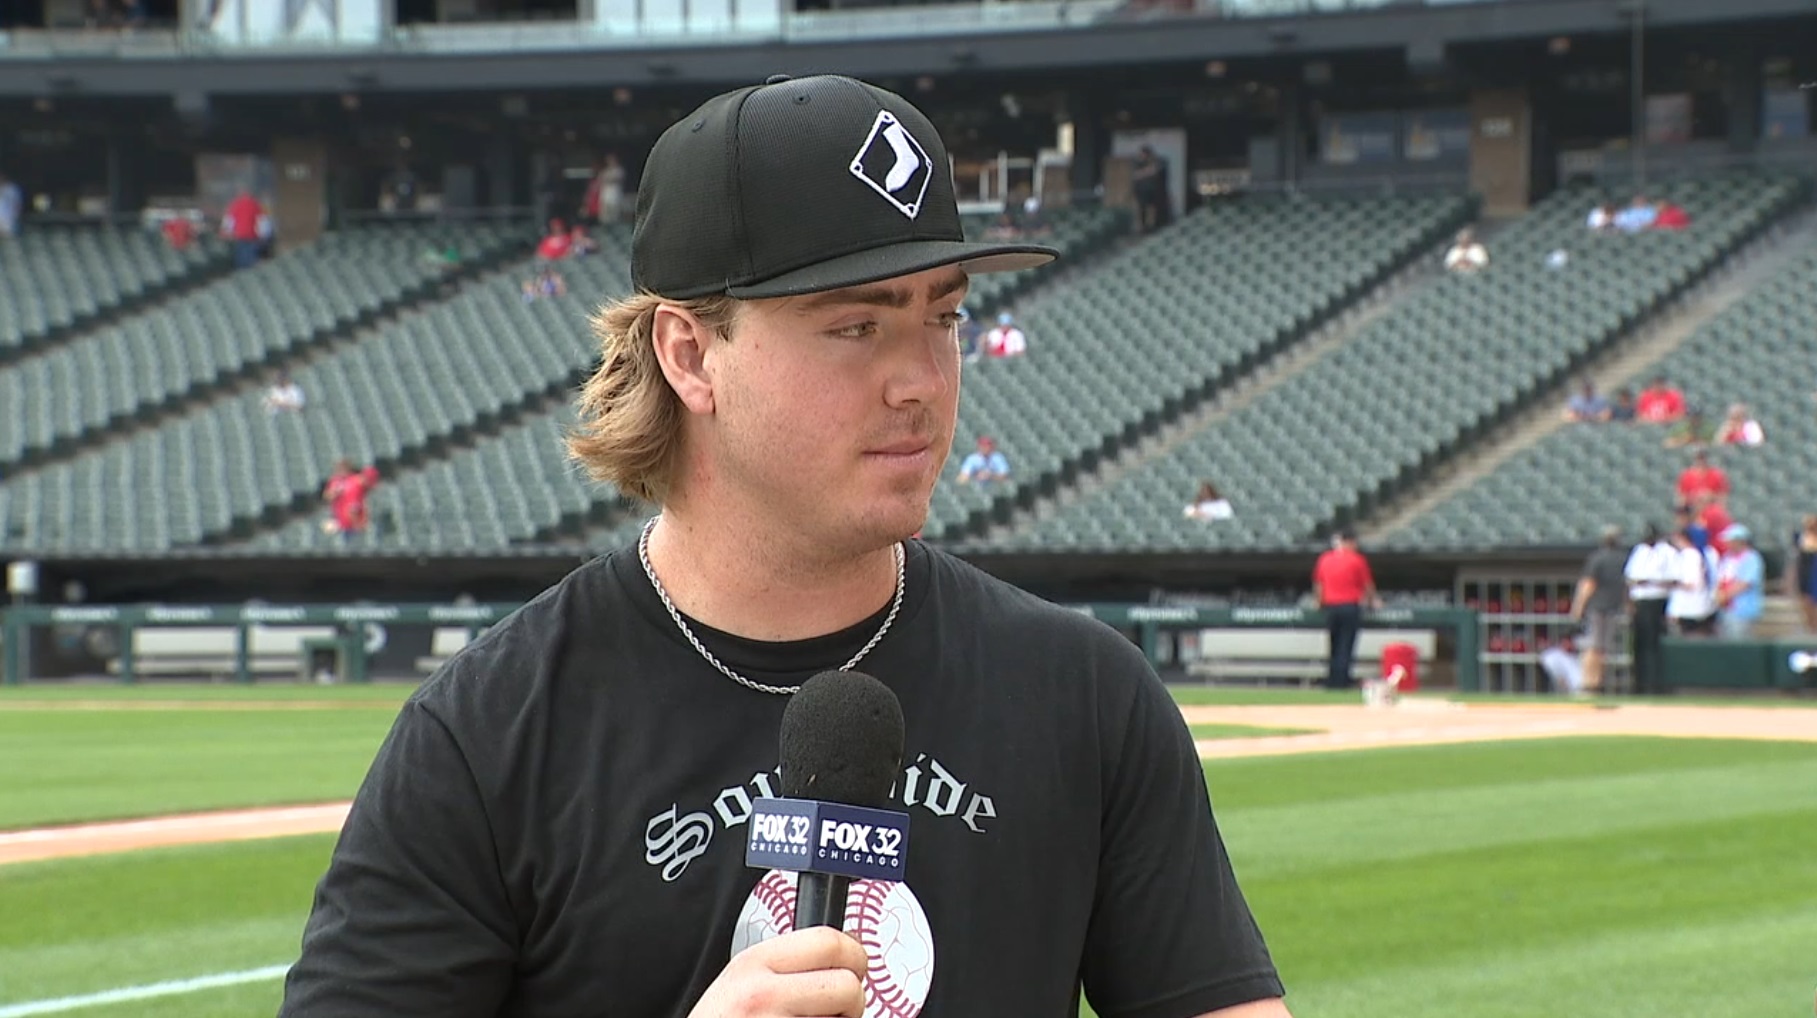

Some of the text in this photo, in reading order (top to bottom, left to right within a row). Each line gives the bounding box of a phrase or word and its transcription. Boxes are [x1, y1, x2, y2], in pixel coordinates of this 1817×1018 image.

[645, 752, 997, 882] Soide
[750, 842, 808, 856] CHICAGO
[819, 819, 902, 857] FOX 32
[818, 848, 899, 868] CHICAGO
